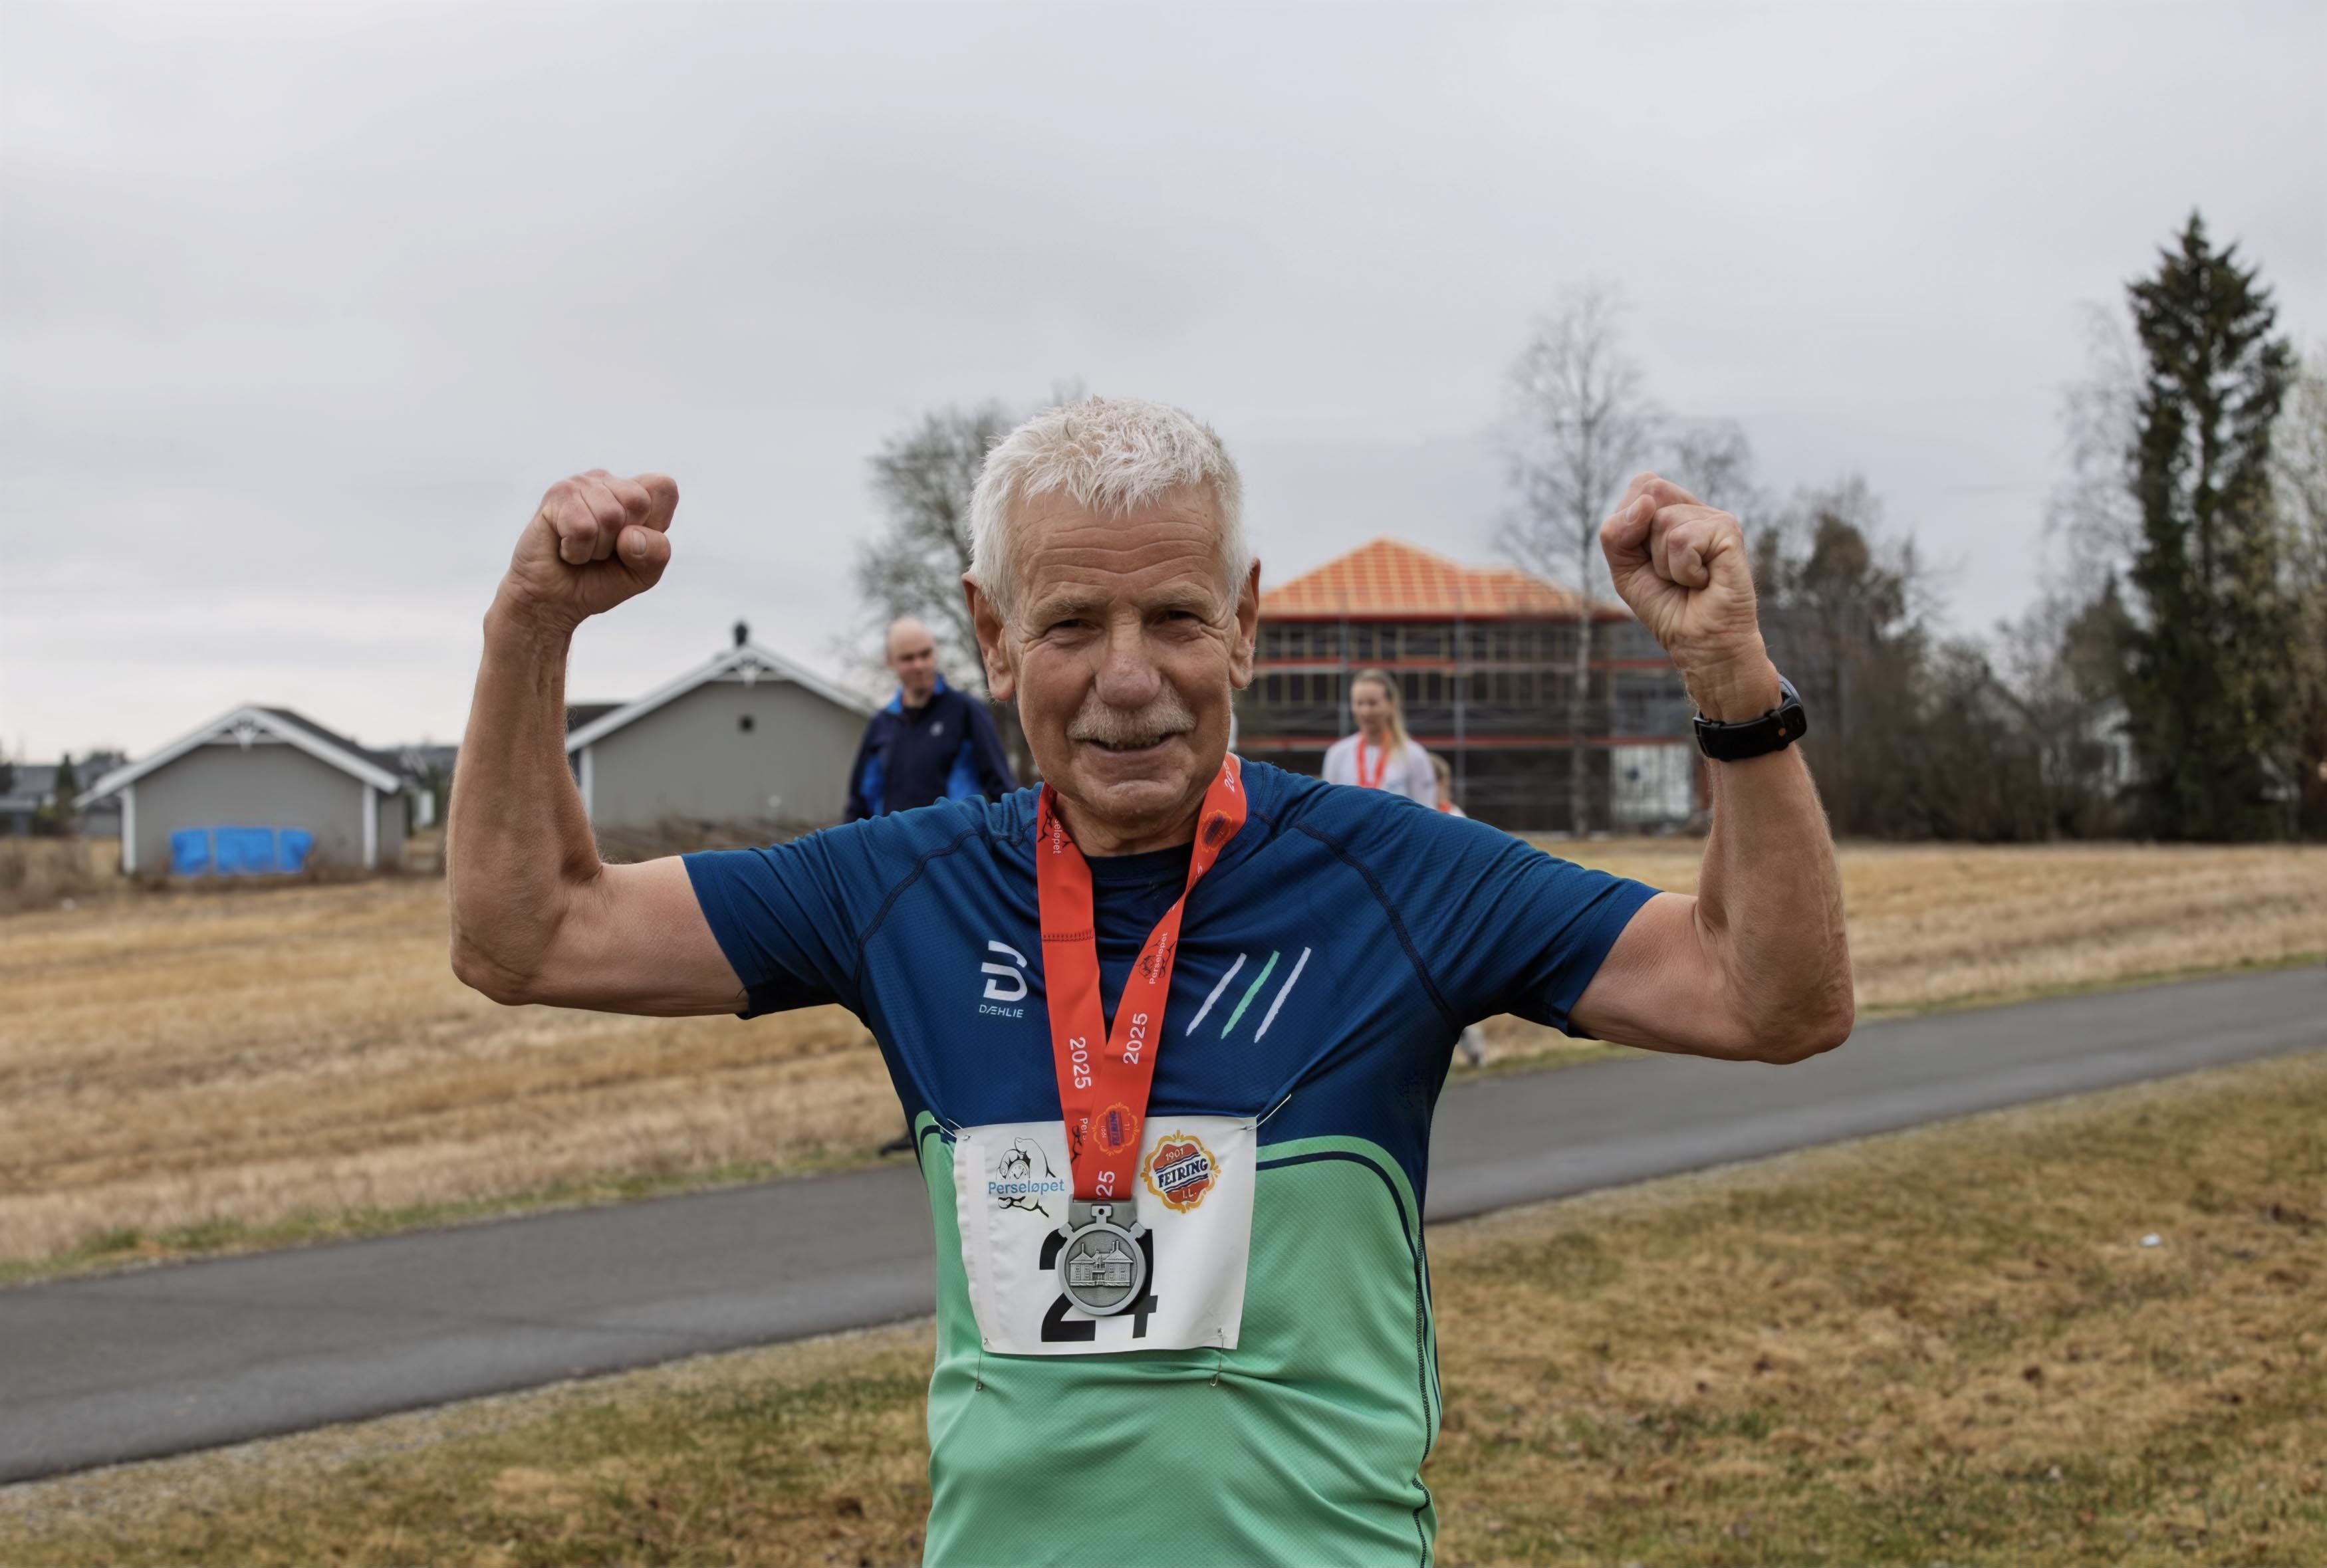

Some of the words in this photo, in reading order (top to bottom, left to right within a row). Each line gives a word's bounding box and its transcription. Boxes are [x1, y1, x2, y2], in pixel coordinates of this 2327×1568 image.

[1122, 1013, 1148, 1065] 2025
[1069, 1036, 1092, 1089] 2025
[1165, 1147, 1183, 1161] 1901
[988, 1178, 1065, 1195] Perseløpet
[1096, 1170, 1116, 1198] 25
[1158, 1158, 1208, 1188] FEIRING
[1182, 1188, 1197, 1198] I.L.
